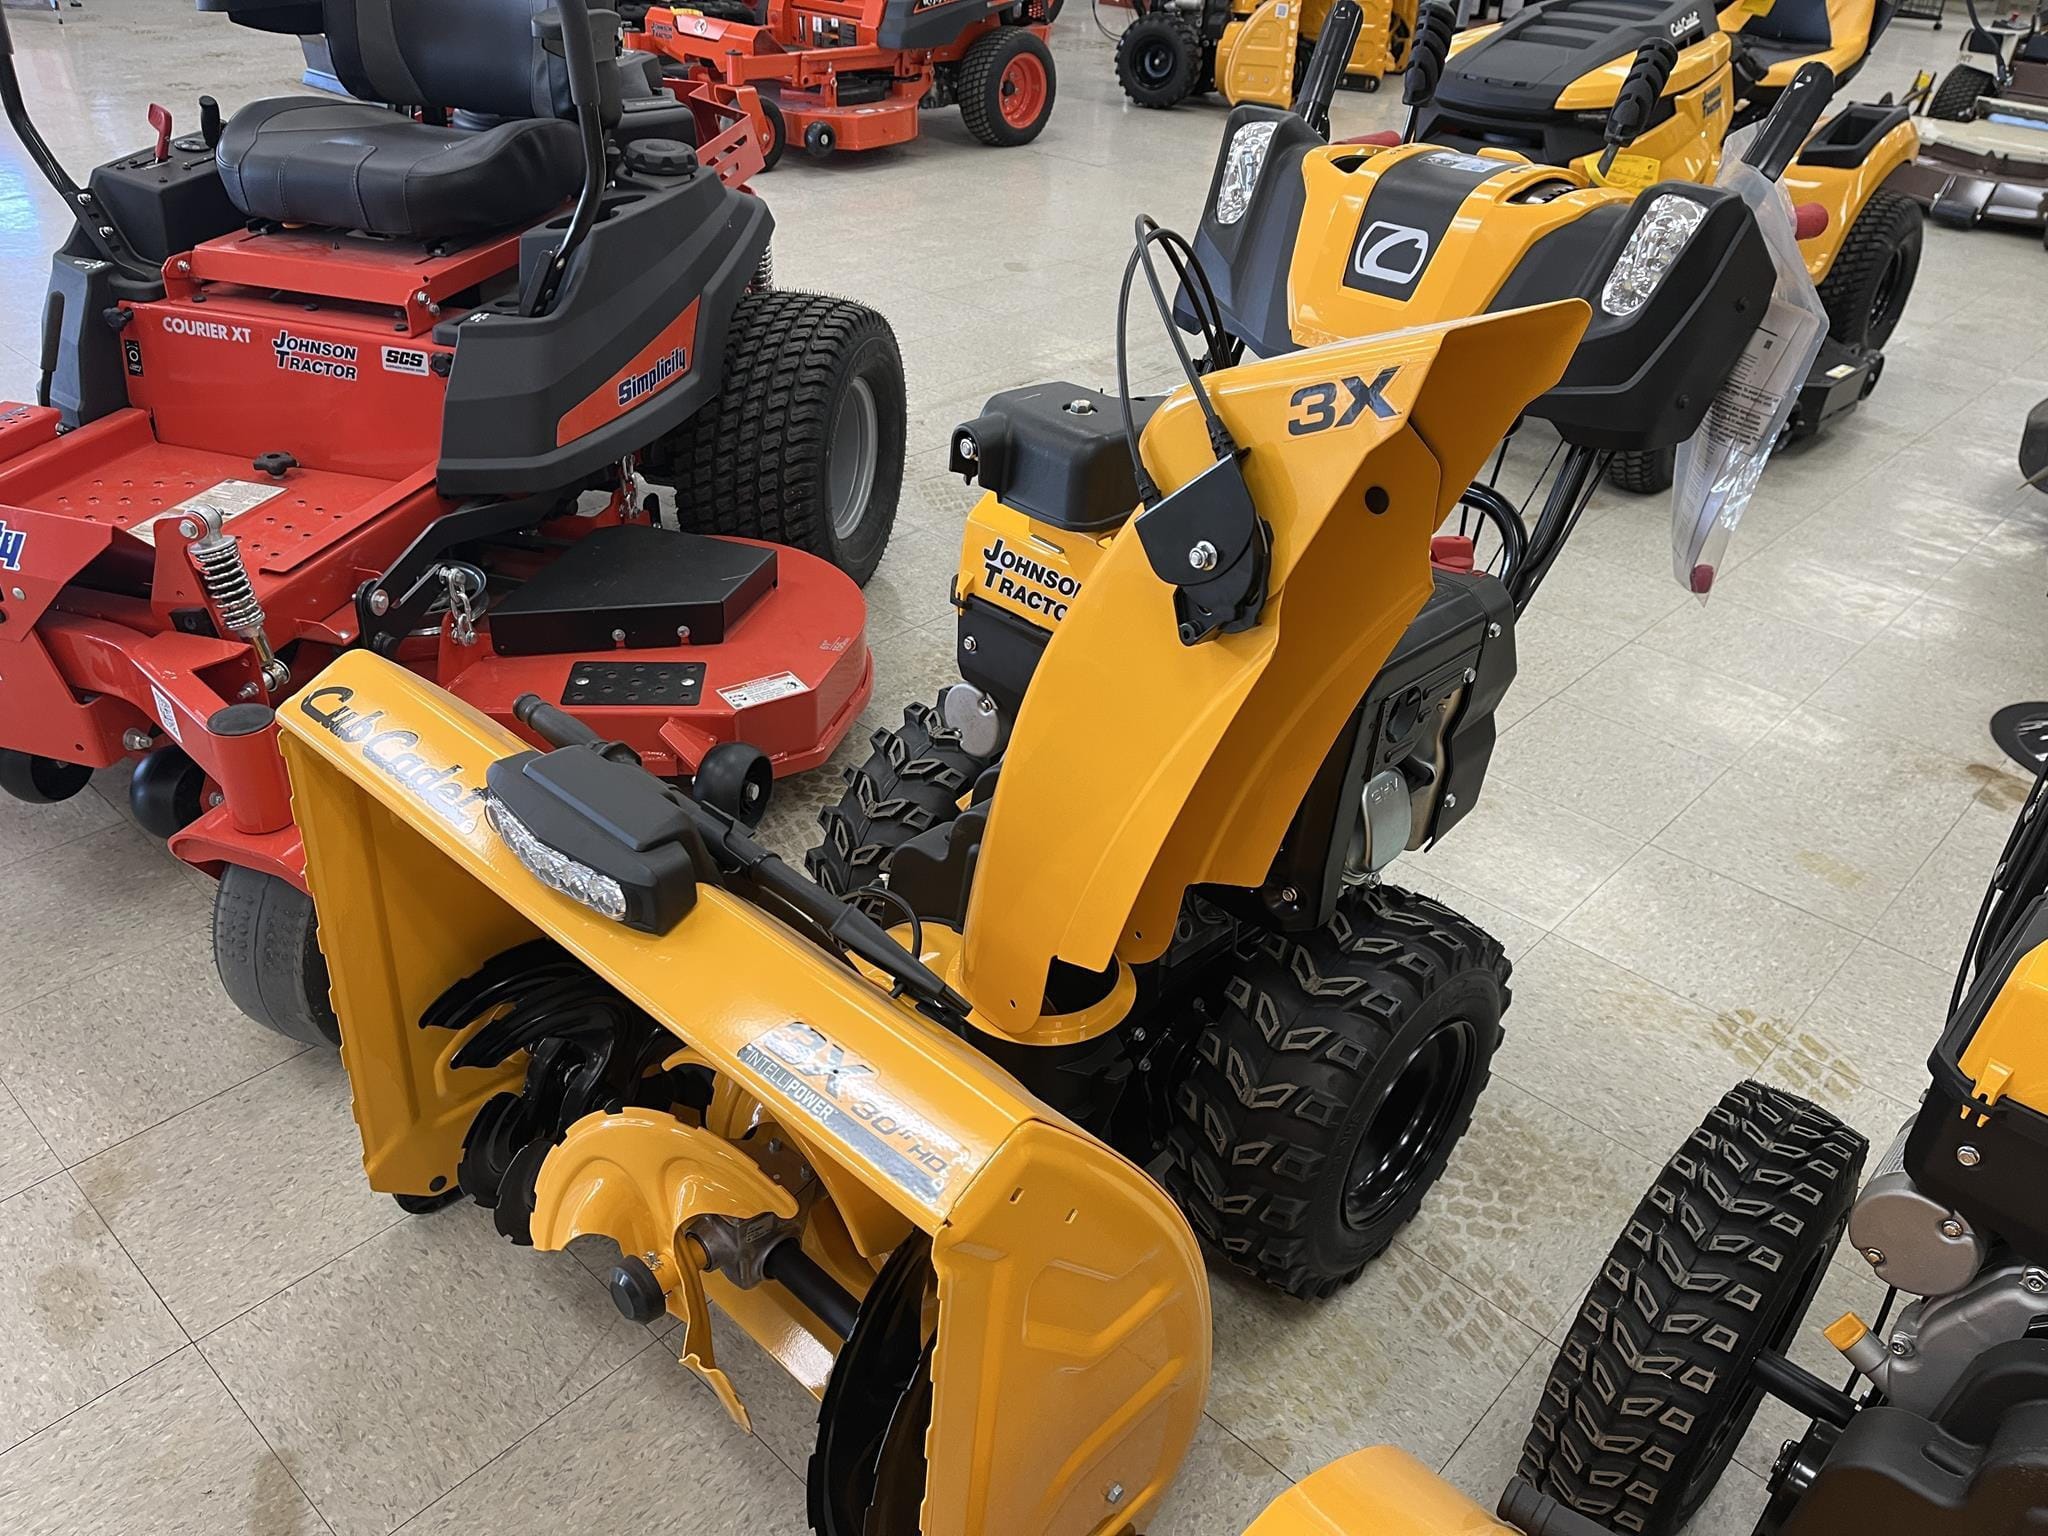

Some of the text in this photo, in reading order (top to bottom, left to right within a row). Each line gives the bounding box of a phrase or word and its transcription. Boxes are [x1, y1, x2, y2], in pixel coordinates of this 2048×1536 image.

[162, 316, 251, 344] COURIER XT
[272, 331, 357, 361] JOHNSON
[386, 349, 424, 367] SCS
[275, 349, 357, 380] TRACTOR
[618, 347, 686, 406] Simplicity
[1288, 365, 1402, 436] 3X
[983, 538, 1082, 599] JOHNSO
[984, 562, 1068, 622] TRACTO
[300, 686, 488, 829] Cub Cadet
[744, 1049, 834, 1121] INTELLIPOWER
[763, 1021, 874, 1100] 3X
[907, 1143, 948, 1173] HD
